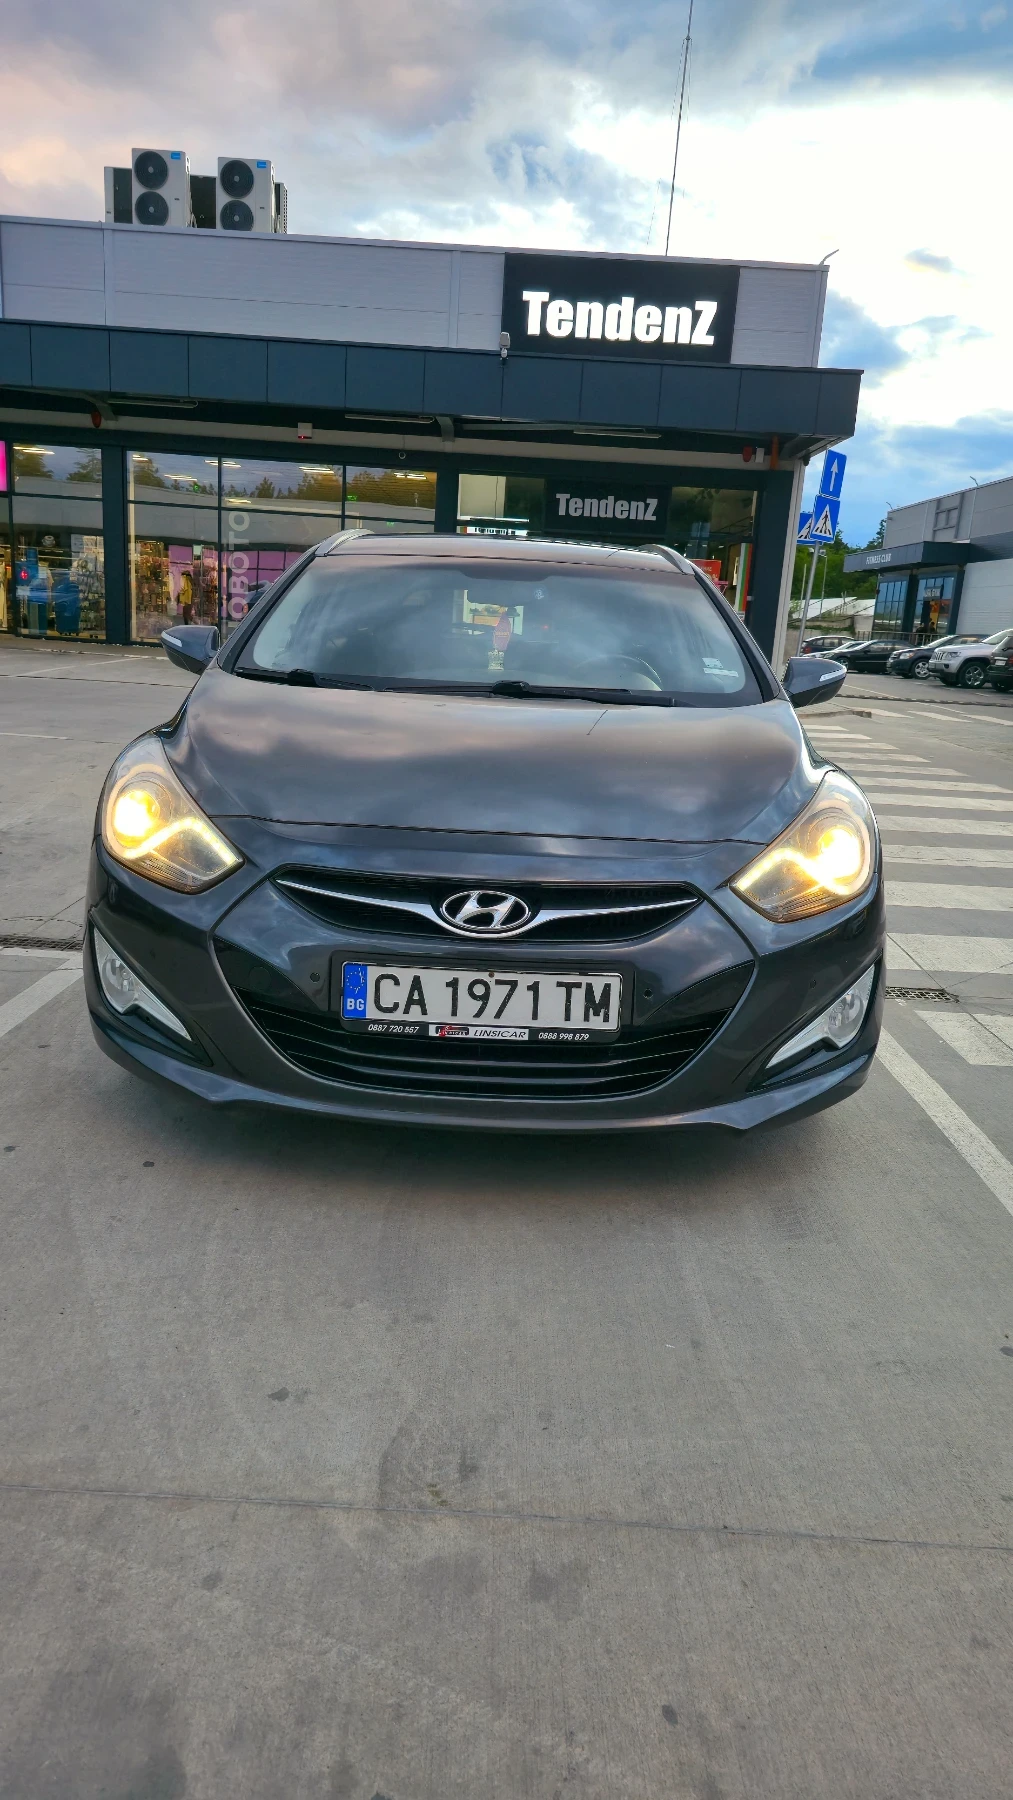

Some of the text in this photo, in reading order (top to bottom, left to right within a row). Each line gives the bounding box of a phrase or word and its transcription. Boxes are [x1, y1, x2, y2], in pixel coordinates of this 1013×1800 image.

[522, 290, 718, 346] TendenZ
[555, 493, 658, 521] TendenZ
[228, 511, 250, 628] ОВОТО
[346, 998, 365, 1011] BG
[373, 973, 612, 1023] CA 1971 TM
[368, 1023, 388, 1032] 0887
[388, 1025, 403, 1033] 720
[473, 1029, 526, 1038] LINSICAR
[538, 1032, 558, 1040] 0888
[574, 1033, 590, 1041] 879
